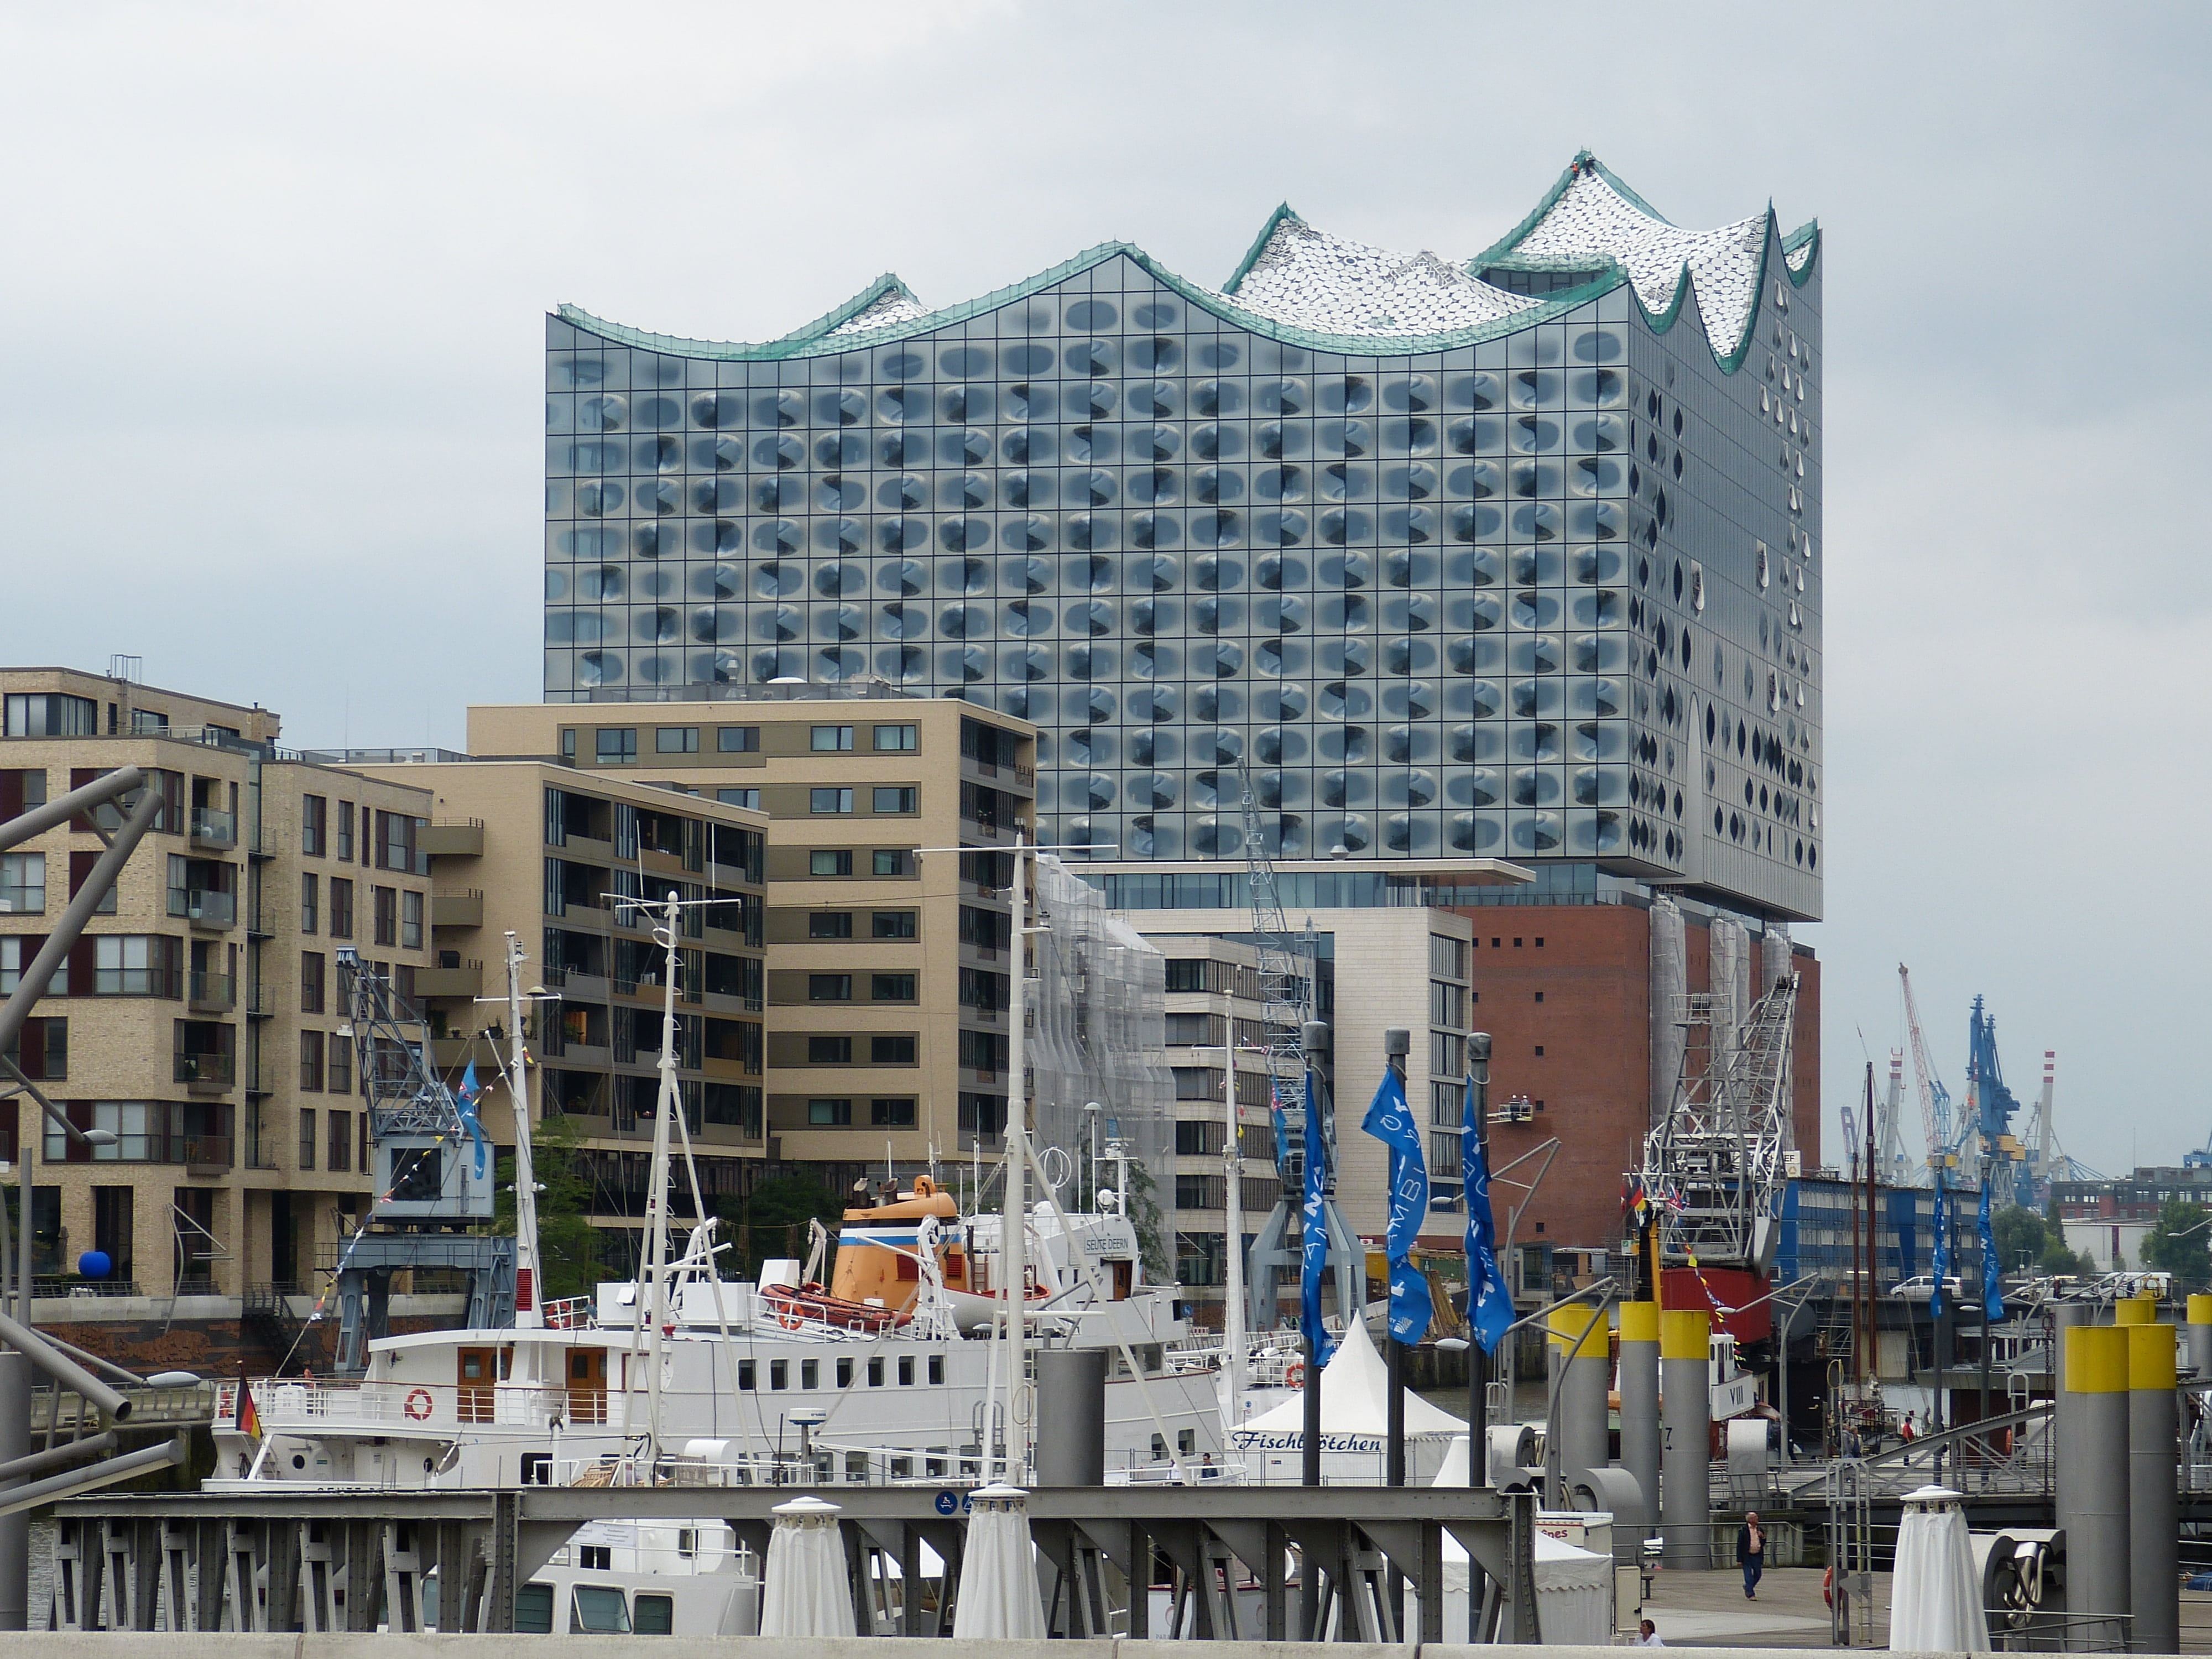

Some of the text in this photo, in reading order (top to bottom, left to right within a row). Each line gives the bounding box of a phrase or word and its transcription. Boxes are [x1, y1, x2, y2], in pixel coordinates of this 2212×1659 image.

[1086, 1238, 1128, 1250] SEUTE DEERN
[1730, 1385, 1744, 1406] VIII
[1232, 1431, 1381, 1451] Fischbötchen
[1665, 1427, 1673, 1442] 7
